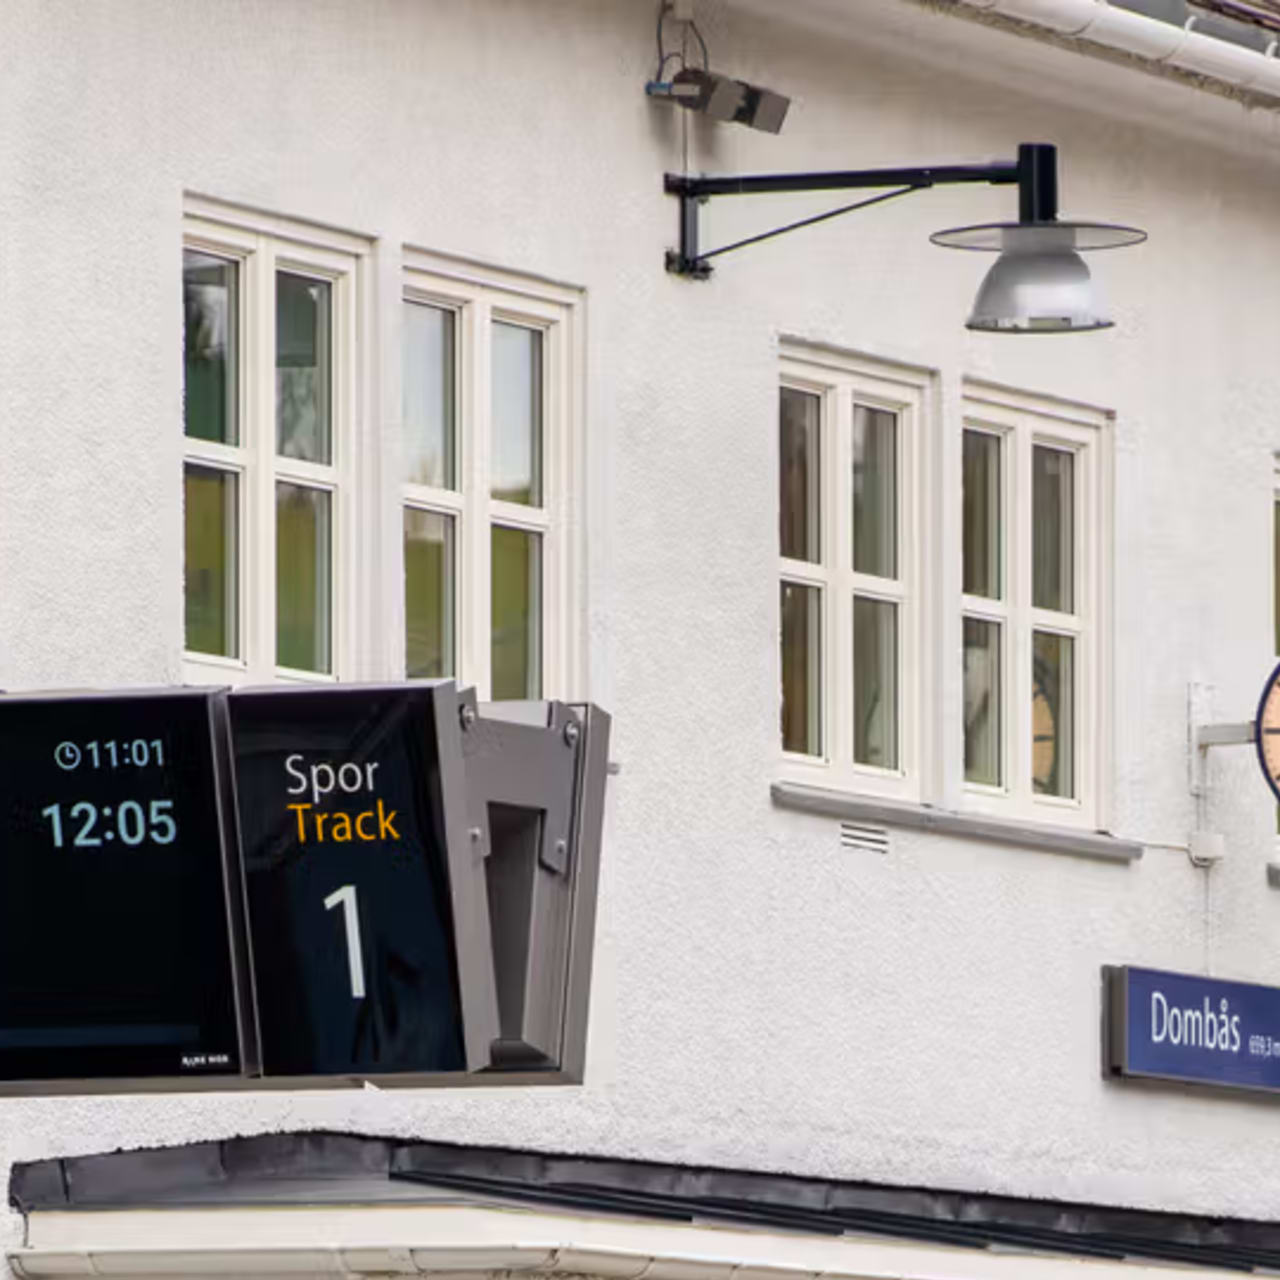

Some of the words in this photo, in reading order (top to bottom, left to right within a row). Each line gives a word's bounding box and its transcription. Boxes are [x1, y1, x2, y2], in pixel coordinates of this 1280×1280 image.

[85, 739, 165, 769] 11:01
[284, 753, 379, 805] Spor
[41, 800, 177, 848] 12:05
[285, 798, 402, 844] Track
[323, 885, 366, 998] 1
[1151, 990, 1241, 1052] Dombås
